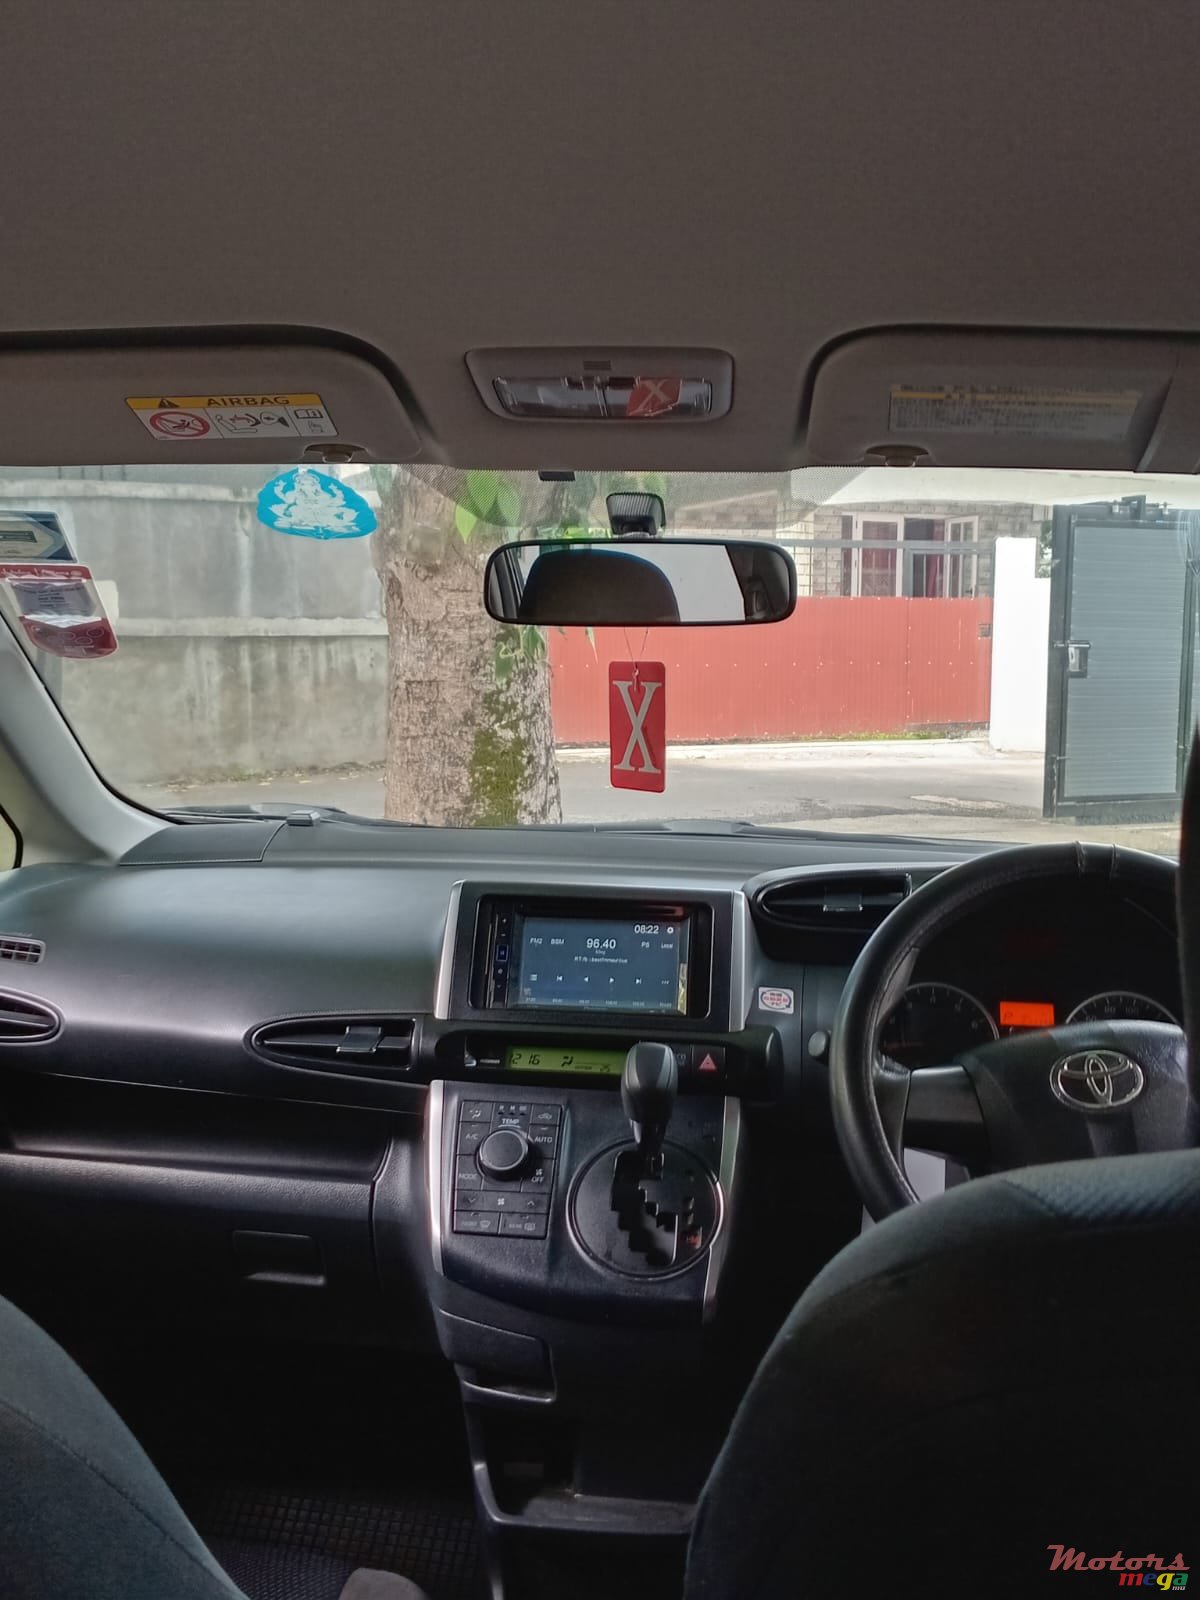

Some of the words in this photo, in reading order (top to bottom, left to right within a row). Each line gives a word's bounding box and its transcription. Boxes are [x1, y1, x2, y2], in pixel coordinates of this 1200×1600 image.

[207, 396, 290, 407] AIRBAG
[612, 680, 664, 774] X
[634, 924, 660, 934] 08:22
[586, 938, 617, 949] 96.40
